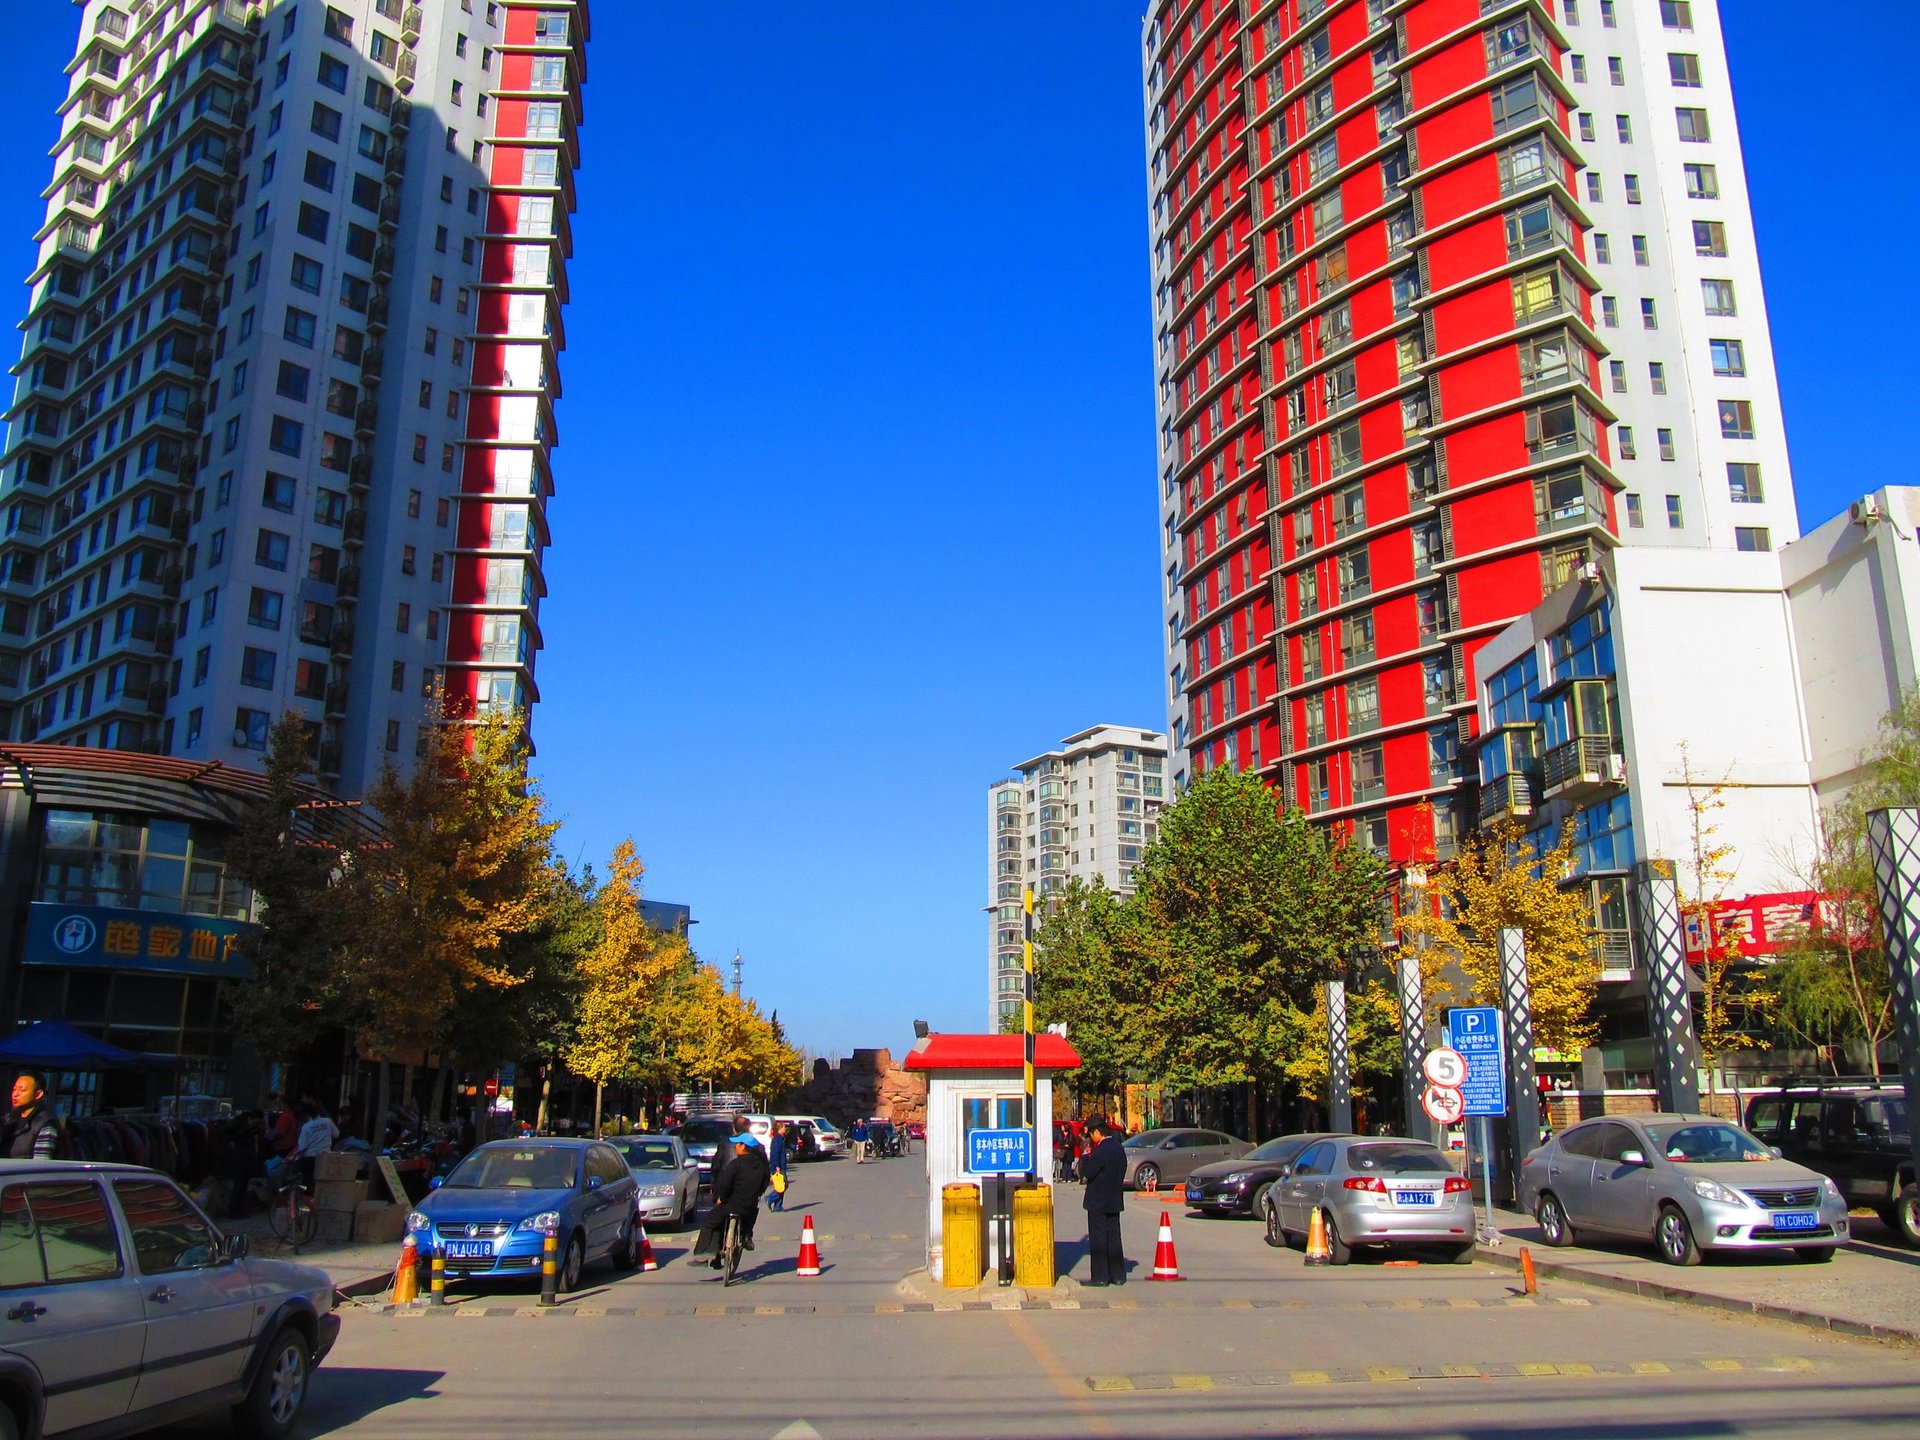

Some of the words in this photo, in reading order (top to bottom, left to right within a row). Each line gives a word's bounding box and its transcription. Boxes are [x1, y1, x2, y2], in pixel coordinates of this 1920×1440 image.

[1466, 1014, 1480, 1032] P
[1454, 1034, 1496, 1046] 小区收费停车场
[1438, 1056, 1455, 1080] 5
[975, 1137, 1025, 1151] 非本小区车辆及人员
[976, 1151, 1025, 1165] 严禁穿行
